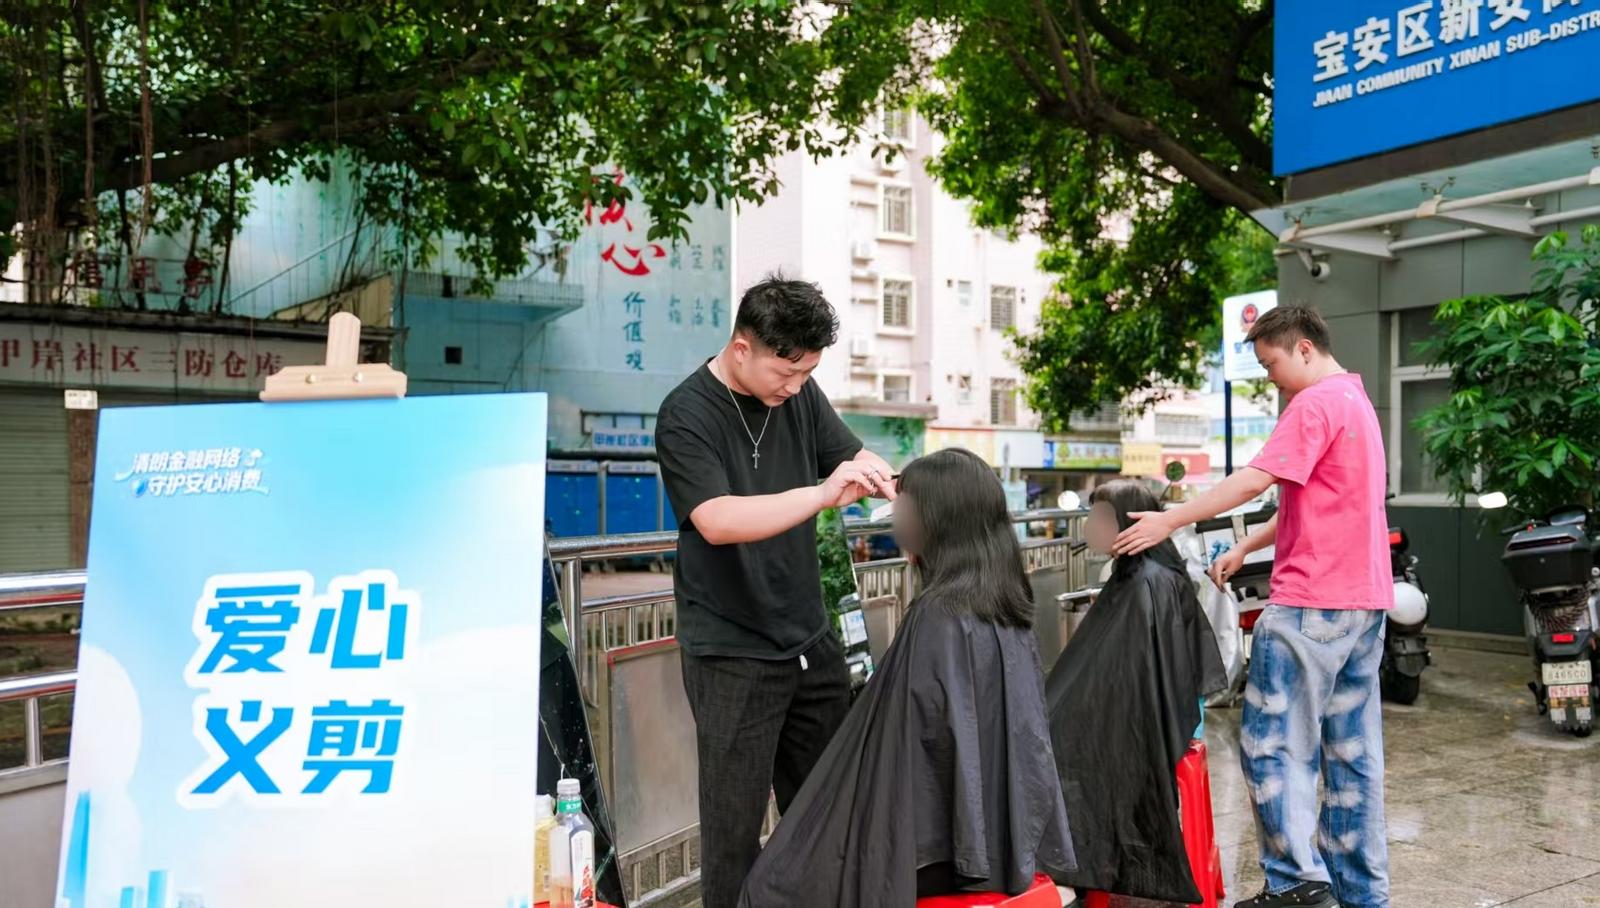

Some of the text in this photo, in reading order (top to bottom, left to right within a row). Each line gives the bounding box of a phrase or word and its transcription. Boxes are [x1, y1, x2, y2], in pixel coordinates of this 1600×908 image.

[1313, 0, 1581, 82] 宝安区新安
[1356, 57, 1445, 95] COMMUNITY
[1450, 40, 1500, 69] XINAN
[131, 448, 242, 474] 清朗金融网络
[149, 469, 263, 497] 守护安心消费
[197, 583, 409, 674] 爱心
[190, 699, 405, 795] 义剪
